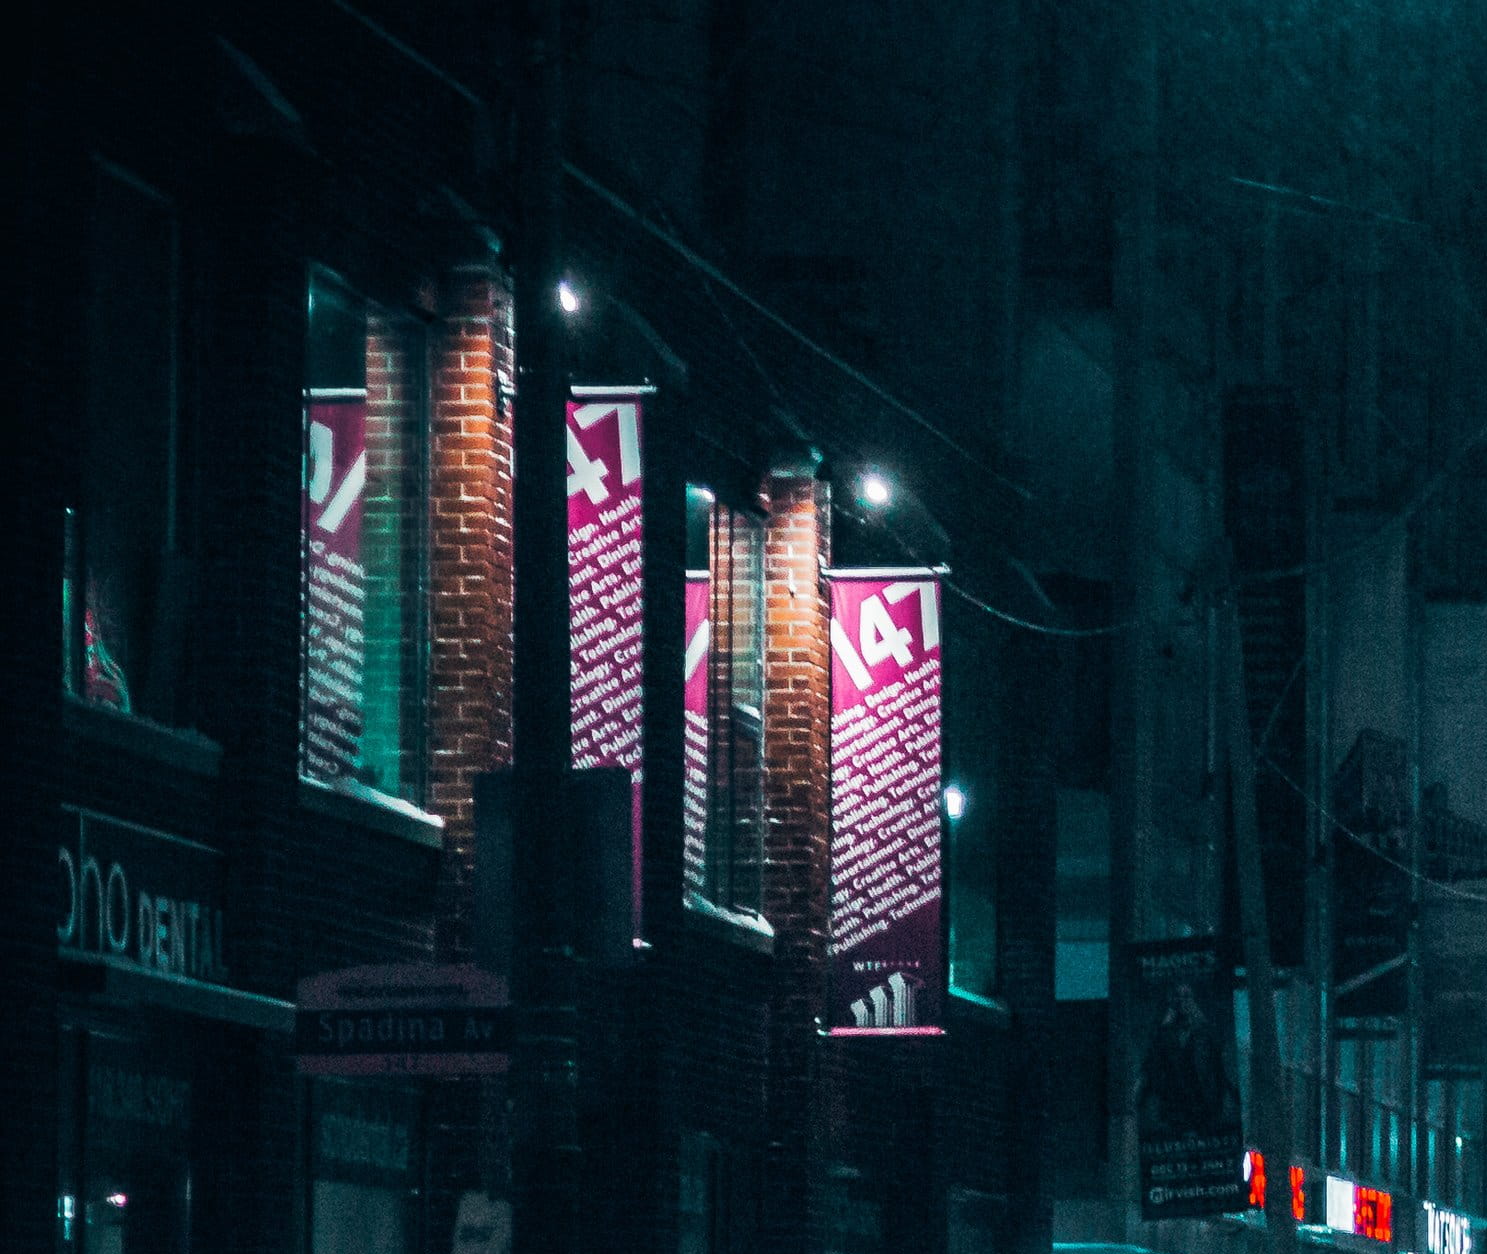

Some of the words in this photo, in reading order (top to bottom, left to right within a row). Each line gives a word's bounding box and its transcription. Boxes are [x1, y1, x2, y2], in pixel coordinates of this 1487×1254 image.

[568, 531, 619, 565] Creative
[570, 590, 590, 607] ive
[591, 574, 621, 593] Arts,
[570, 606, 599, 628] alth,
[830, 582, 940, 691] 147
[622, 662, 642, 682] Art
[832, 794, 862, 815] ealth,
[830, 917, 862, 937] ealth,
[318, 1013, 445, 1047] Spadina
[464, 1016, 494, 1040] Av
